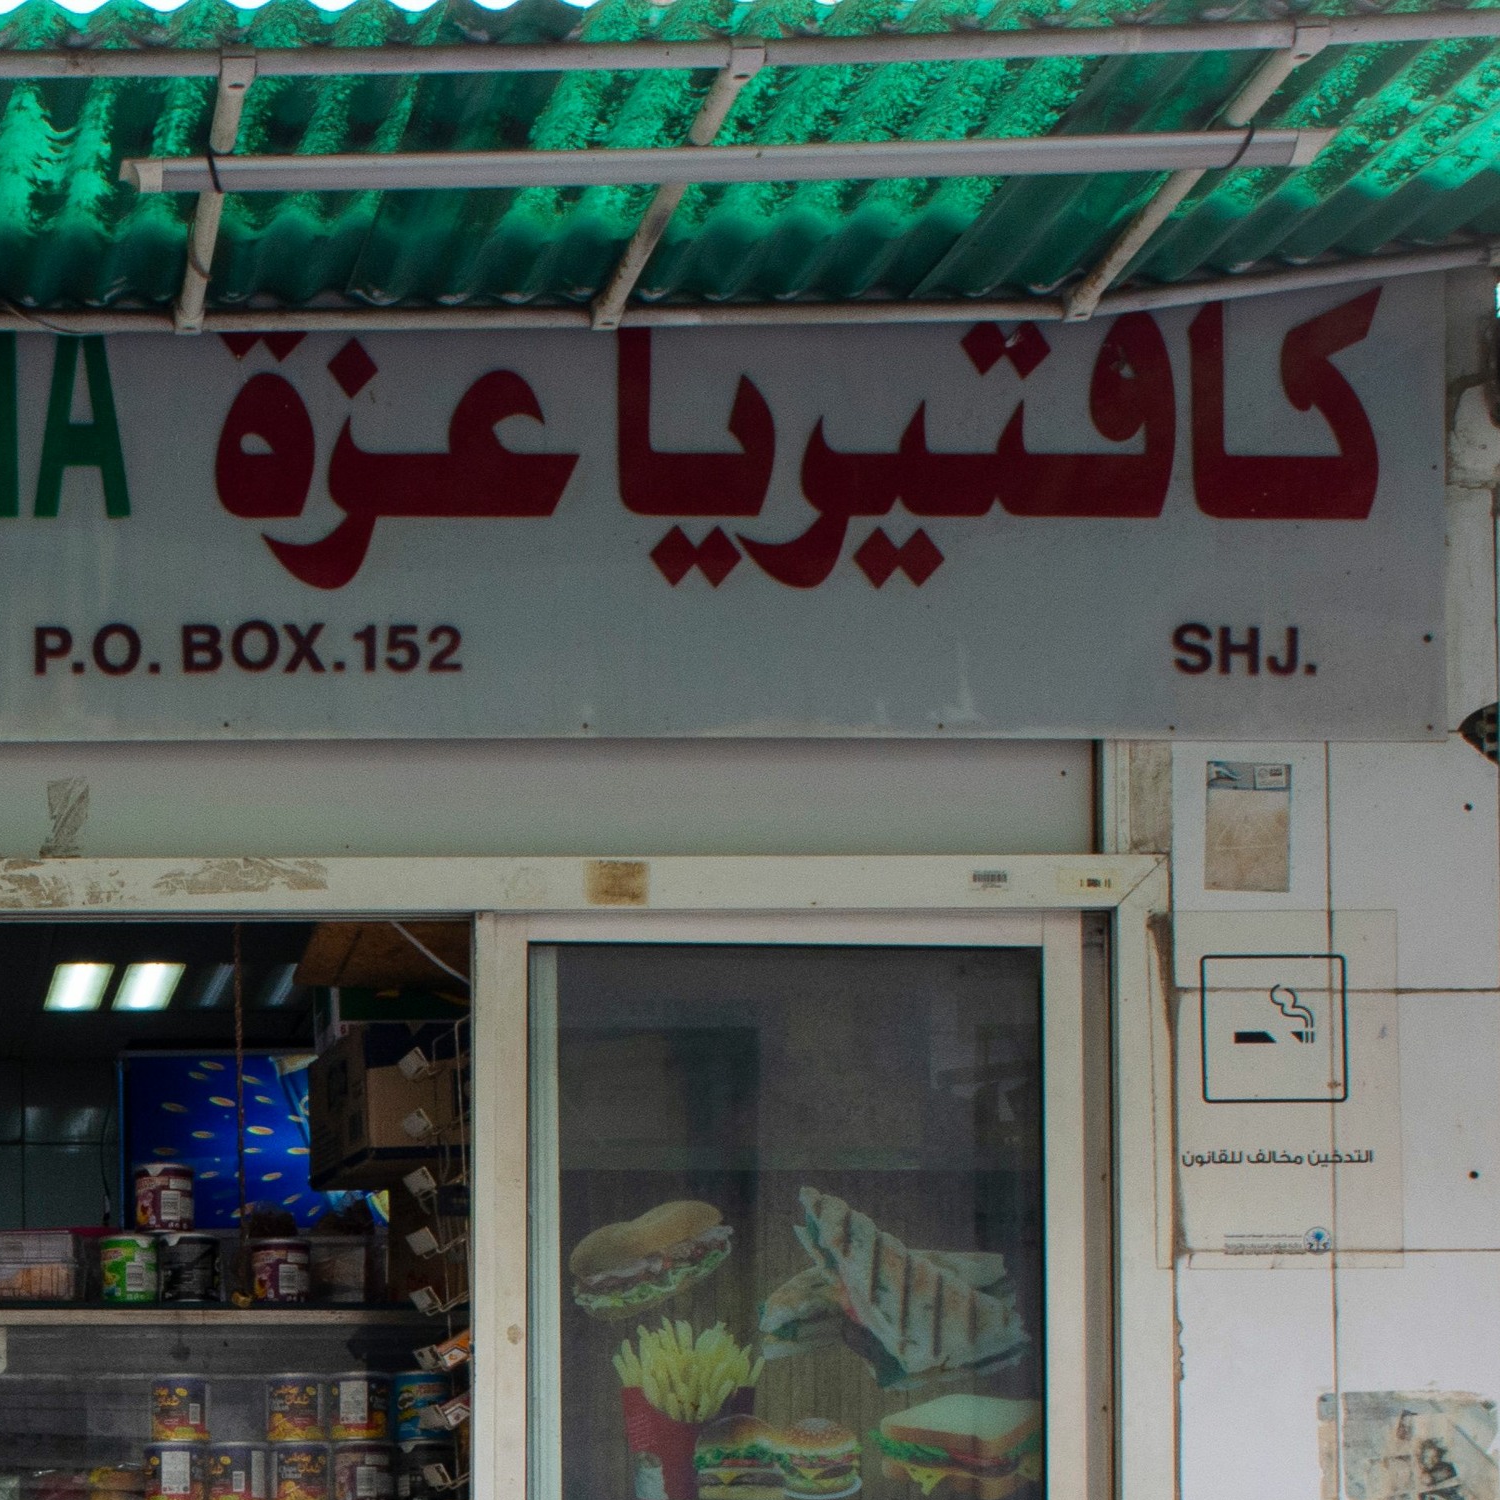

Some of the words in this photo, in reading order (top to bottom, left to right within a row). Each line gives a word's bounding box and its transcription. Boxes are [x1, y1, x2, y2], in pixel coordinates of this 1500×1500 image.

[214, 331, 581, 590] عزة
[615, 286, 1383, 589] كافتيريا
[33, 622, 161, 676] P.O.
[181, 619, 463, 674] BOX.152
[1171, 622, 1318, 677] SHJ.
[1182, 1148, 1243, 1168] للقانون
[1247, 1148, 1303, 1166] مخالف
[1307, 1148, 1374, 1167] التدخين
